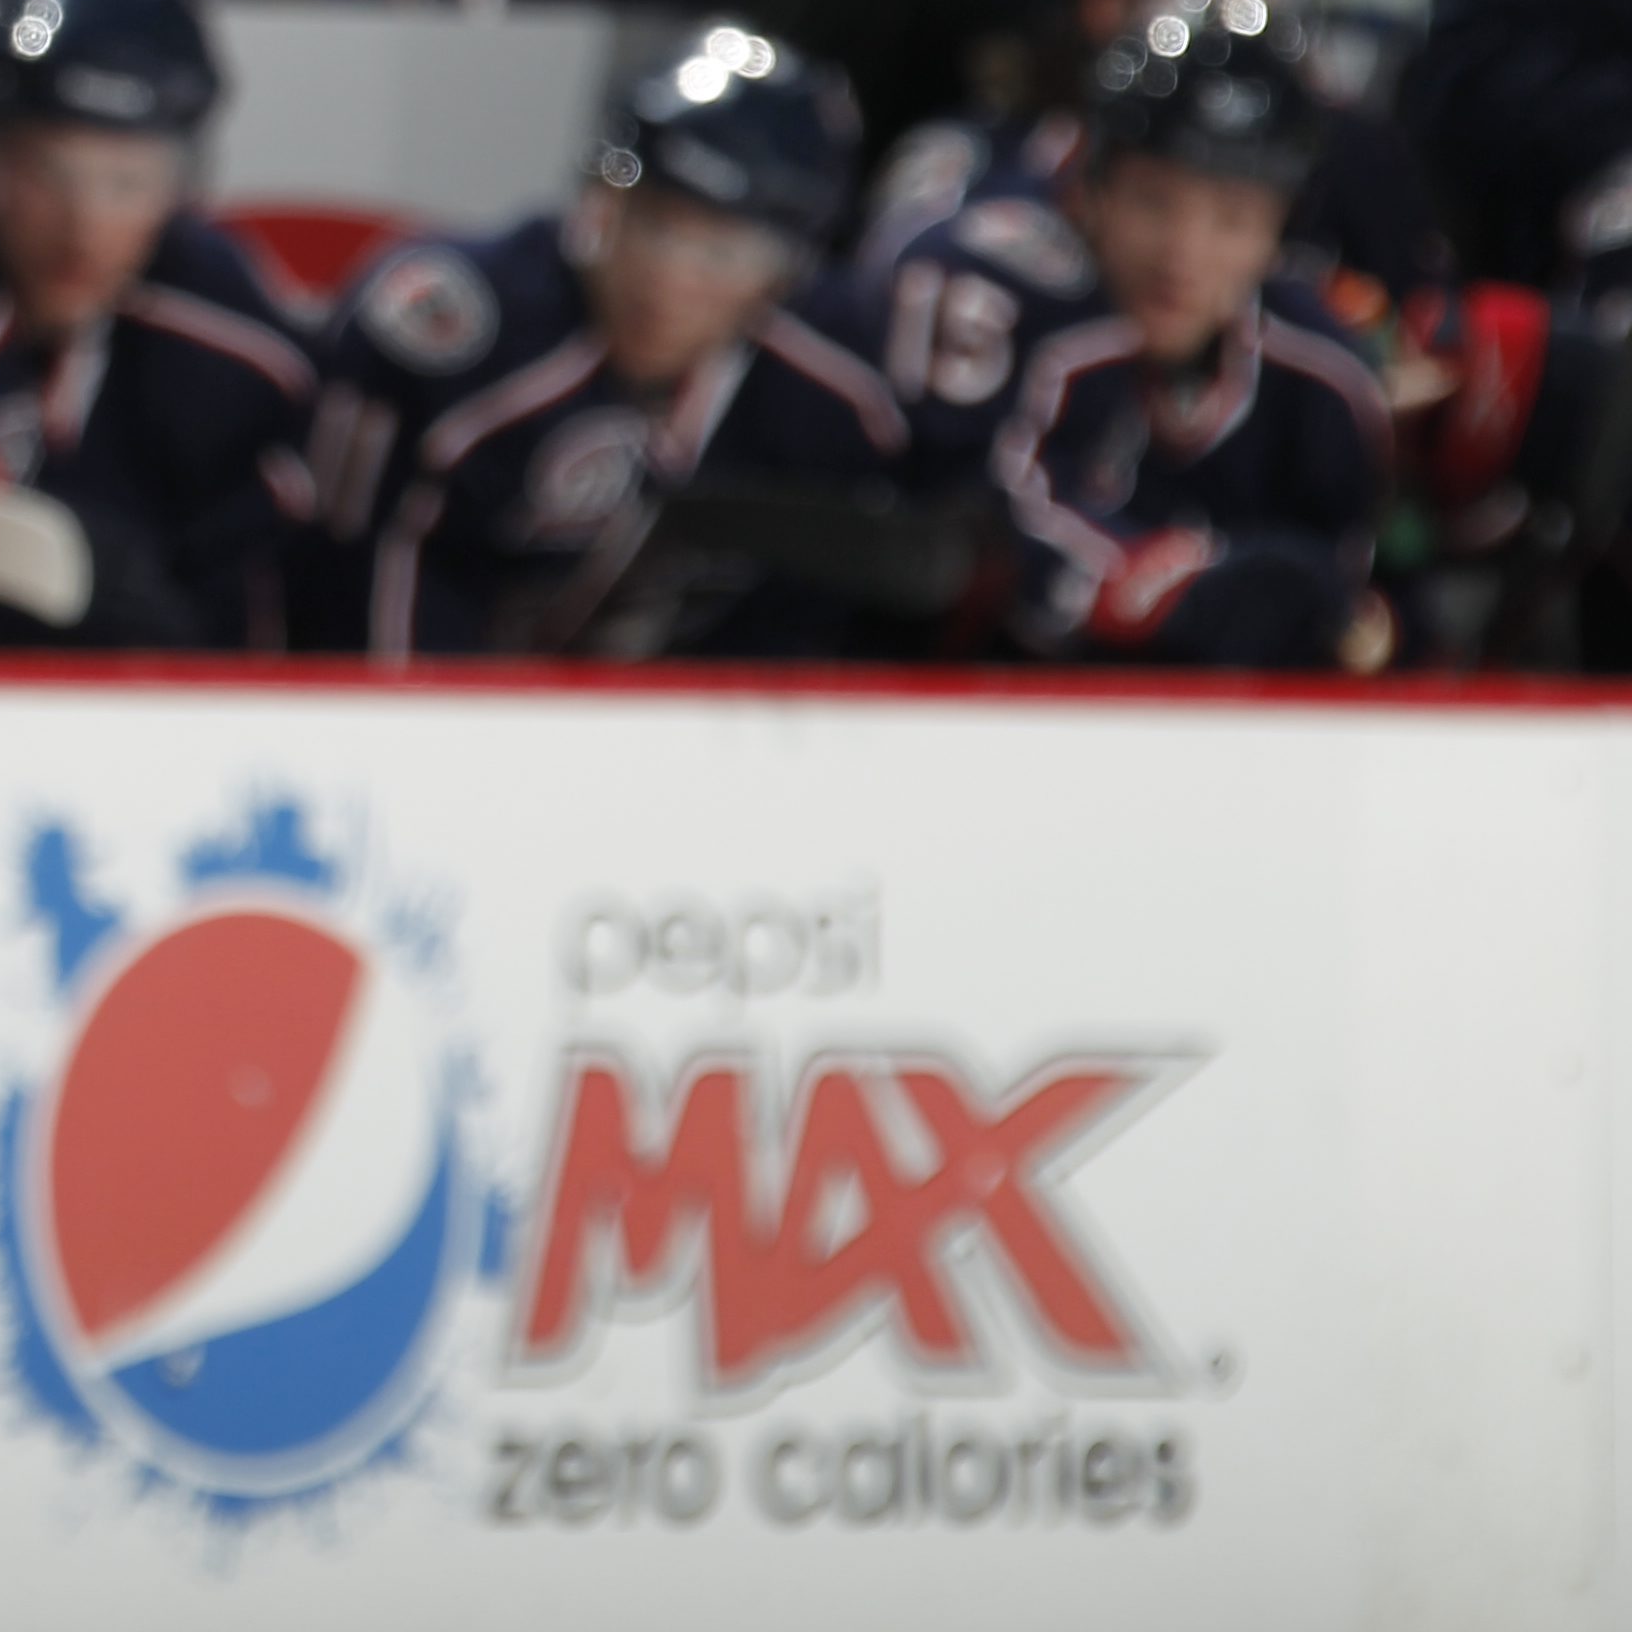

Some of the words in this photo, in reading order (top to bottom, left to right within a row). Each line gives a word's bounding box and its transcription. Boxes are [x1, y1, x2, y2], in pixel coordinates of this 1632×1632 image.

[560, 878, 882, 1026] pepsi
[498, 1040, 1218, 1411] MAX
[483, 1426, 723, 1530] zero
[748, 1412, 1200, 1530] calories
